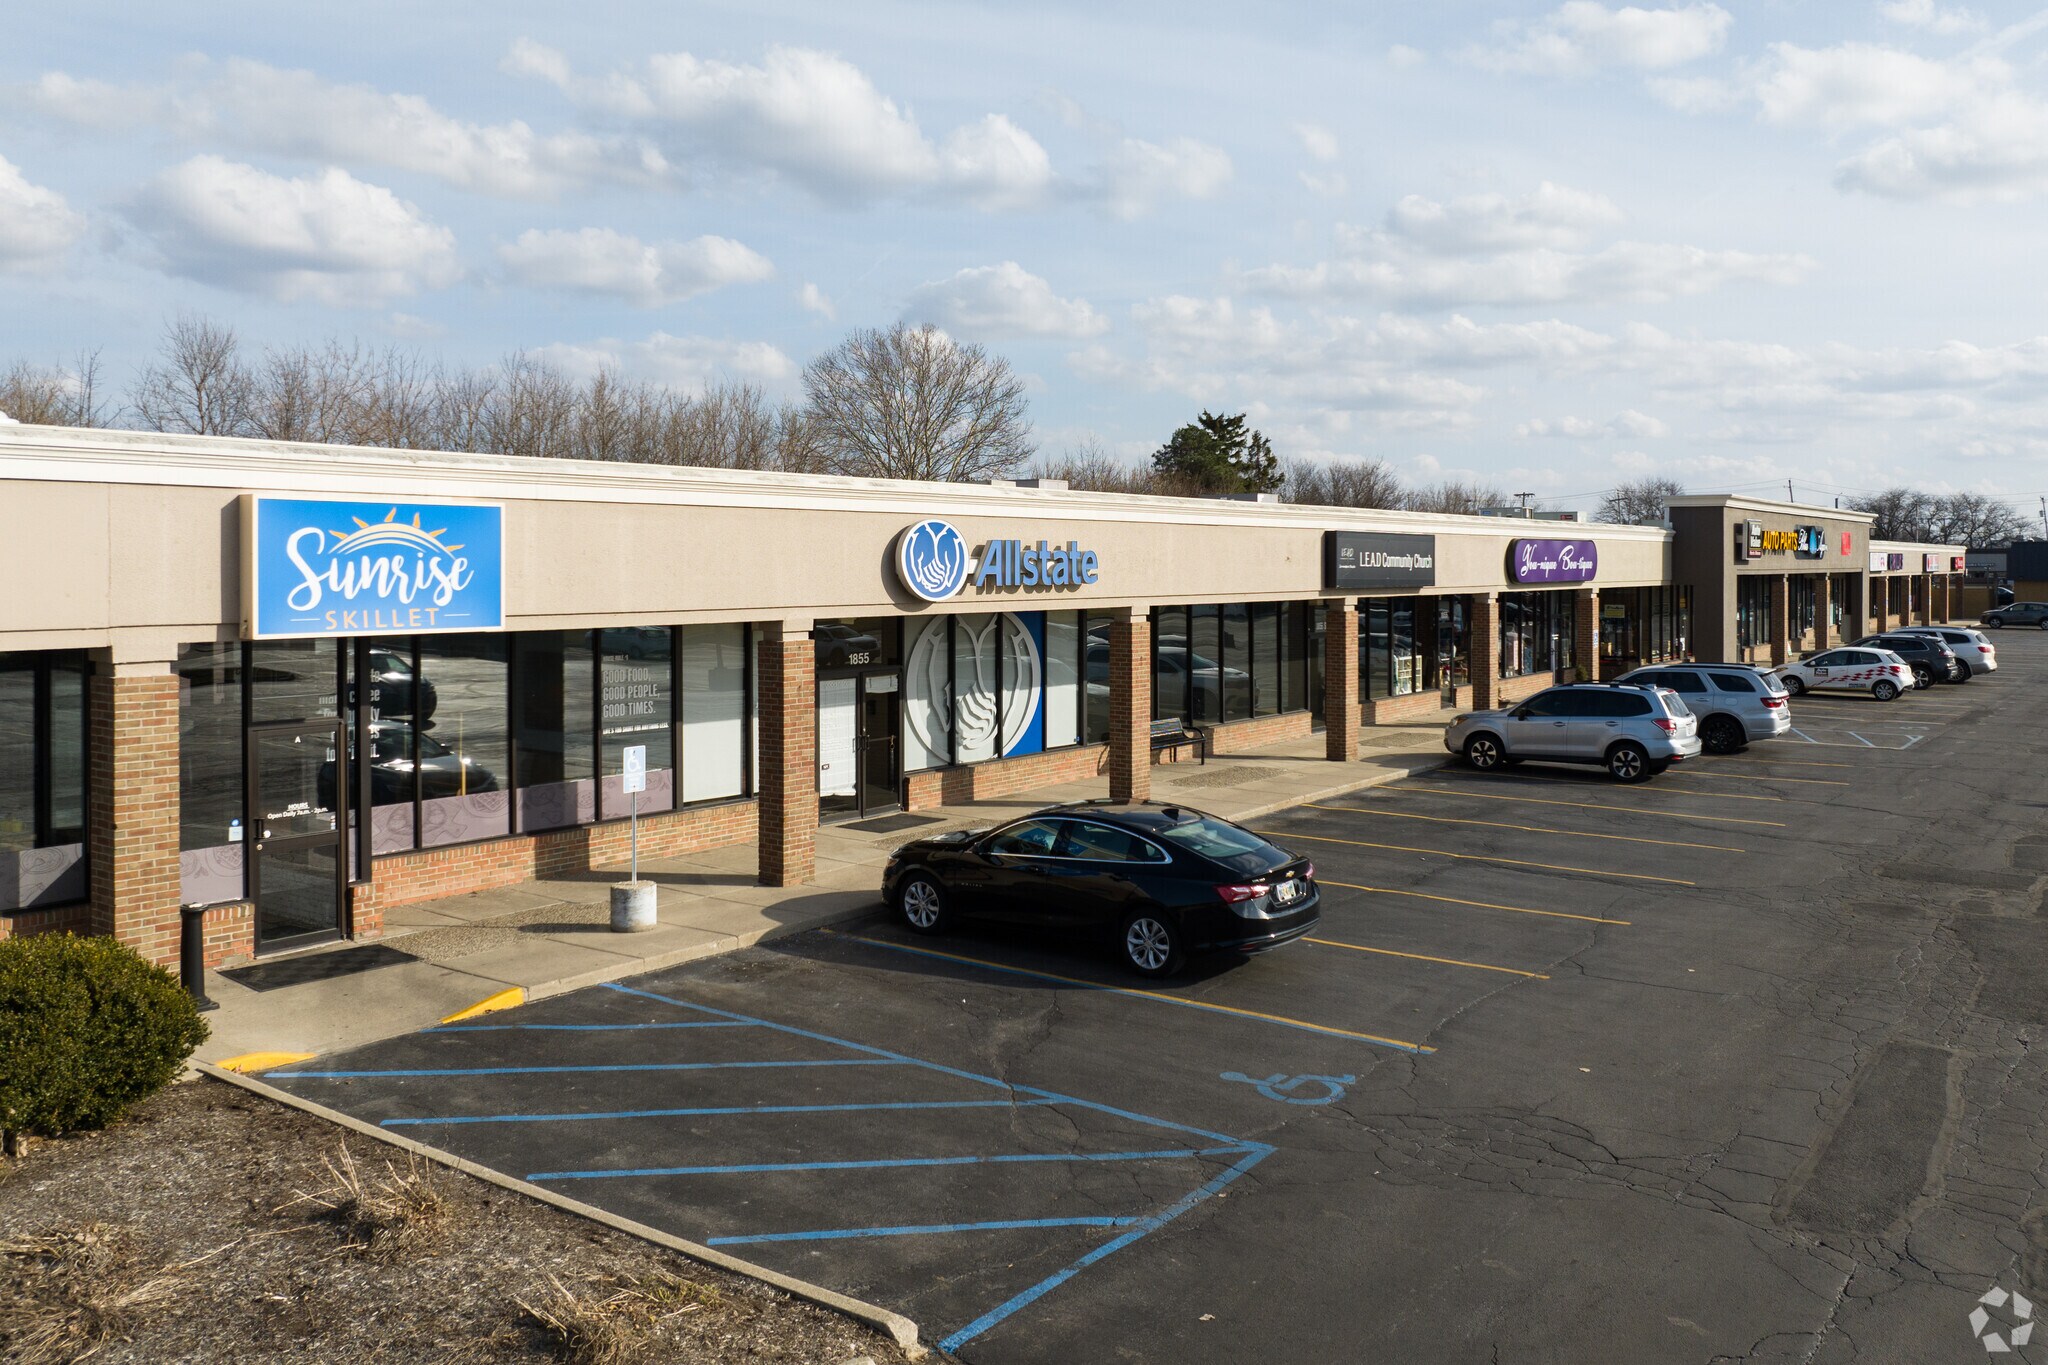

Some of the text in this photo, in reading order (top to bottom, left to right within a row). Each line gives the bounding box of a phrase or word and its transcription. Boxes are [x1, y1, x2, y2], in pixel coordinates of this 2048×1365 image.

[1763, 531, 1779, 550] AUTO
[1780, 531, 1798, 551] PARTS
[286, 526, 475, 612] Sunrise
[976, 540, 1099, 587] Allstate
[1360, 551, 1432, 571] LEAD Community Church
[325, 607, 440, 631] SKILLET
[848, 652, 870, 665] 1855
[603, 668, 651, 684] GOOD FOOD,
[603, 683, 660, 701] GOOD PEOPLE,
[603, 701, 656, 718] GOOD TIMES.
[267, 812, 283, 820] Open
[283, 810, 296, 818] Daily
